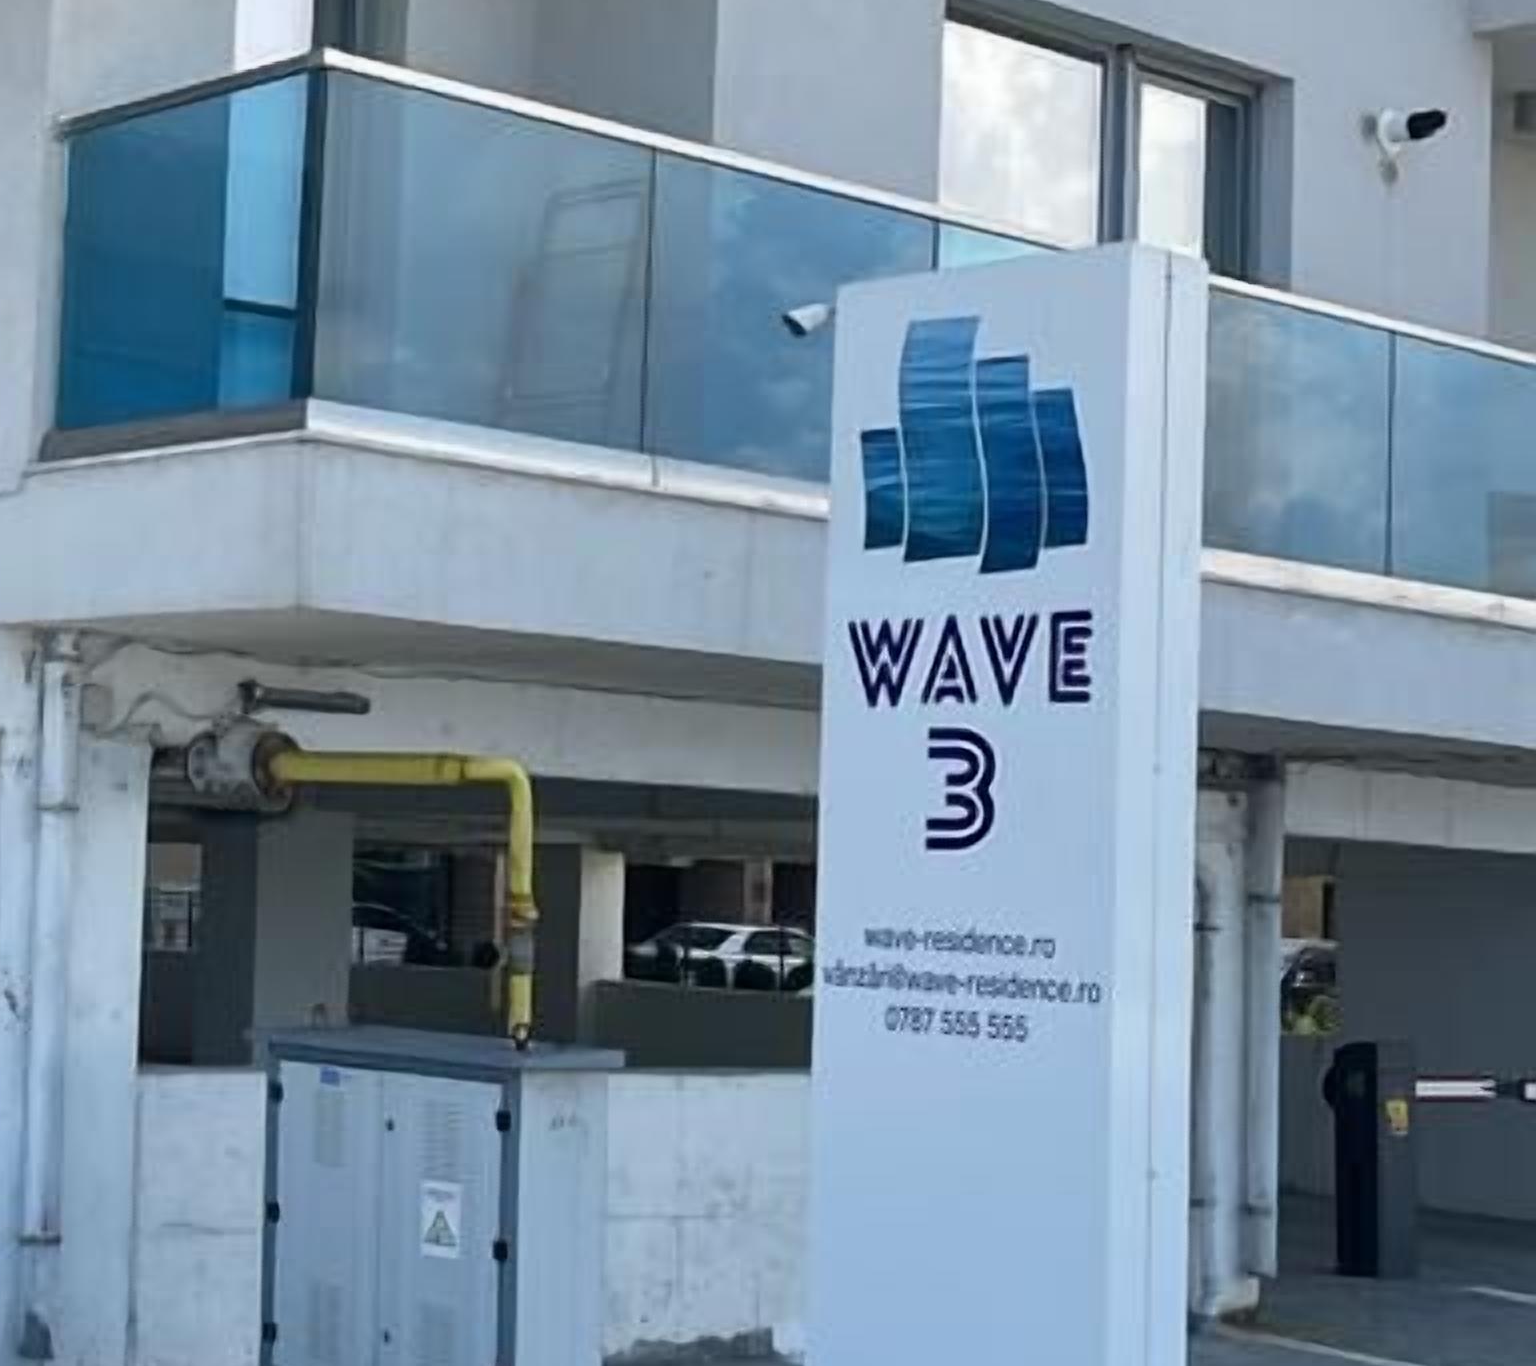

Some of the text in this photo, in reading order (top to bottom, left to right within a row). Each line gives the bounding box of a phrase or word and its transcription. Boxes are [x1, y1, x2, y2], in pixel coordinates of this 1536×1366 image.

[848, 609, 1093, 708] WAVE
[925, 727, 997, 851] 3
[864, 927, 1057, 959] wave-residence.ro
[884, 1005, 935, 1034] 0787
